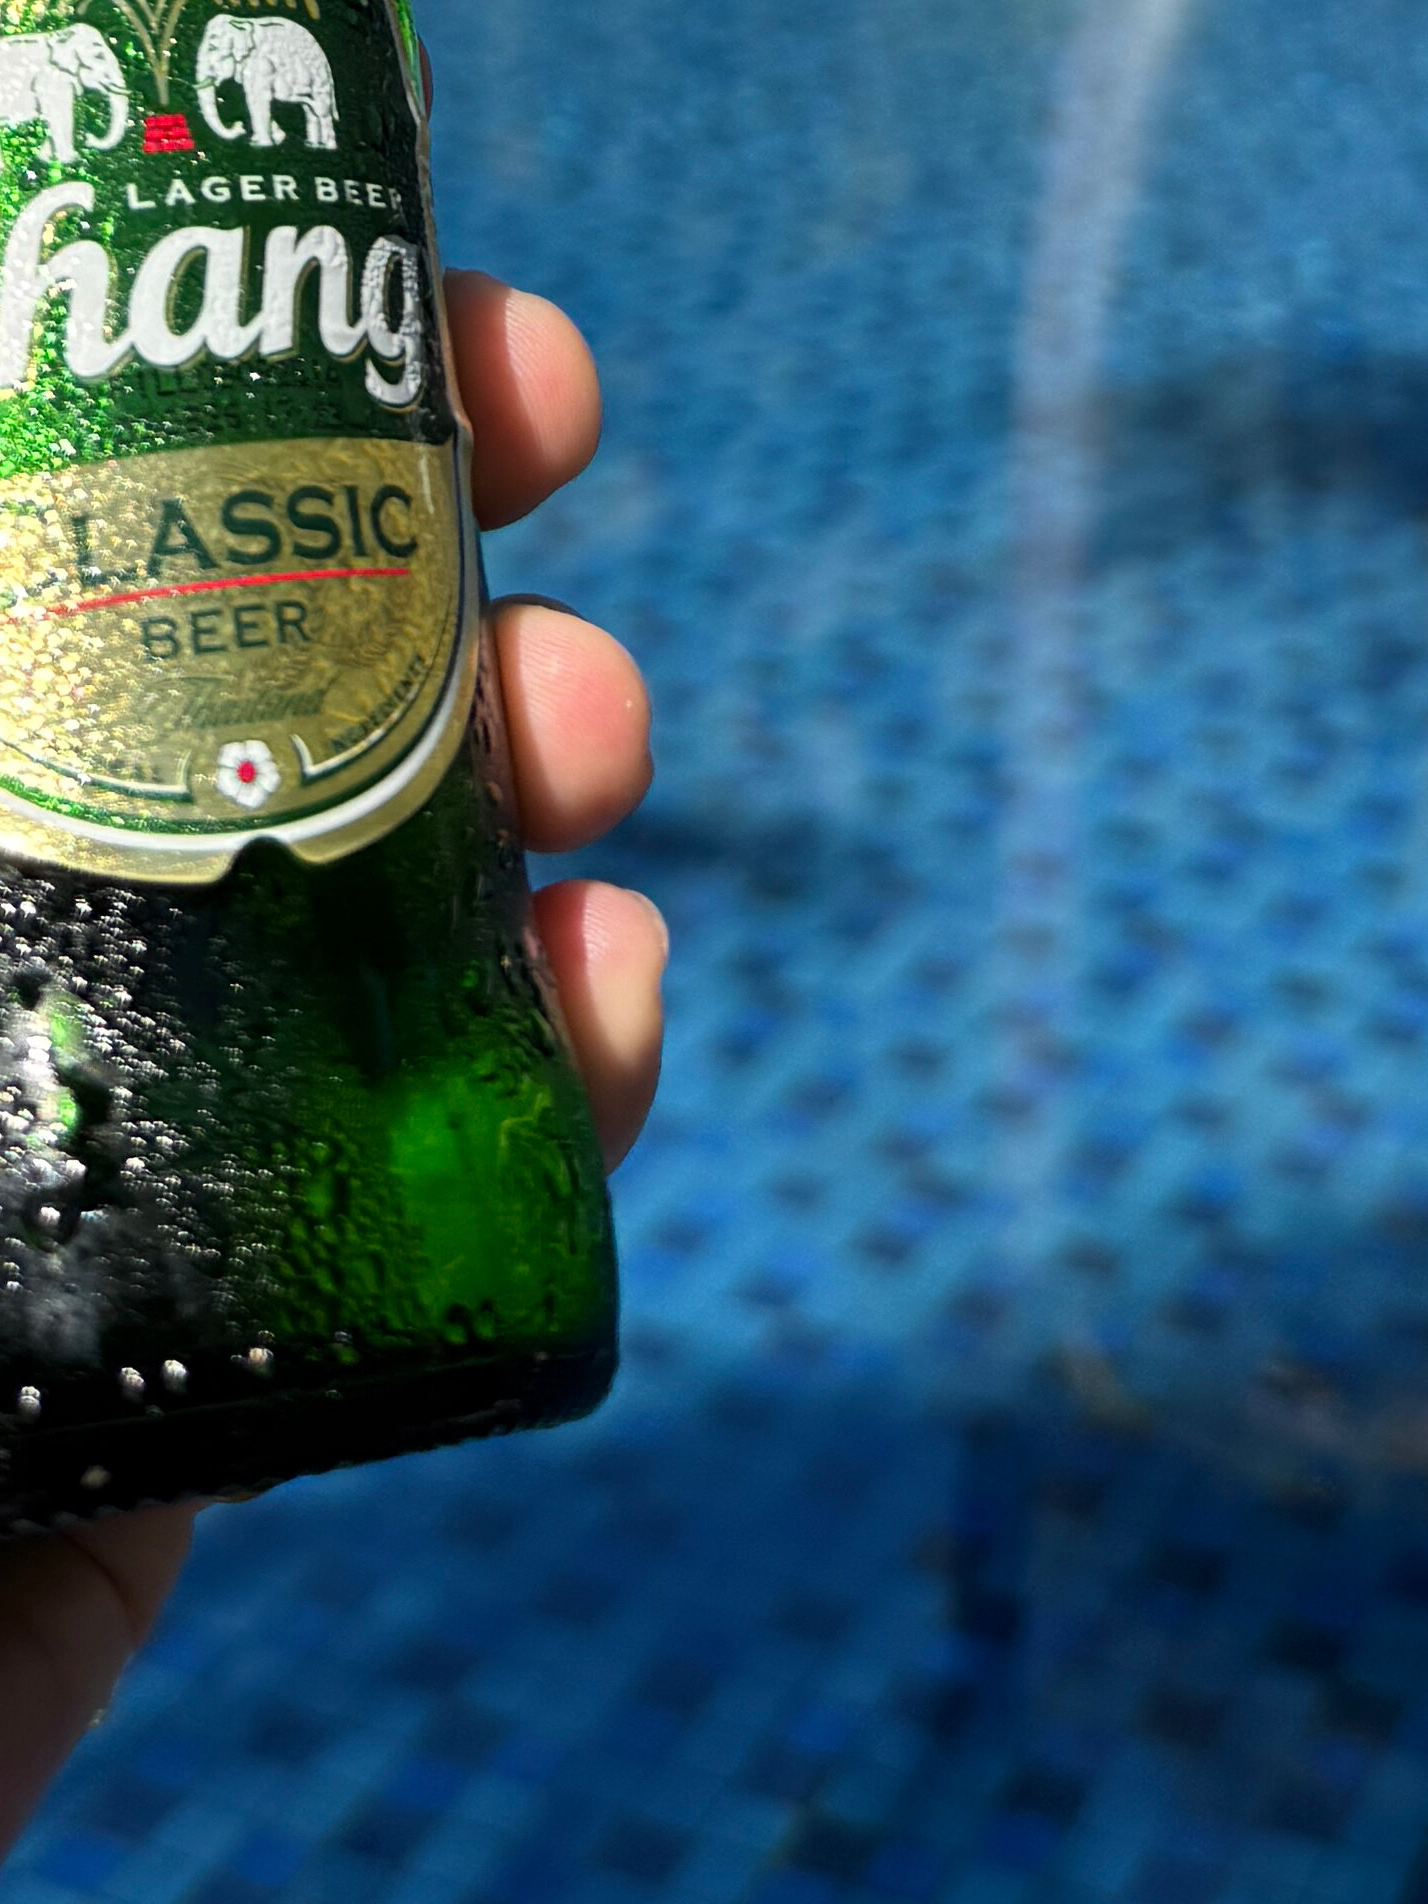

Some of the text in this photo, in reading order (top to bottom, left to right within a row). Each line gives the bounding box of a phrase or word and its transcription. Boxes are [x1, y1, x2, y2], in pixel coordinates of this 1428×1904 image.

[125, 174, 402, 211] LAGER BEER
[141, 599, 312, 661] BEER
